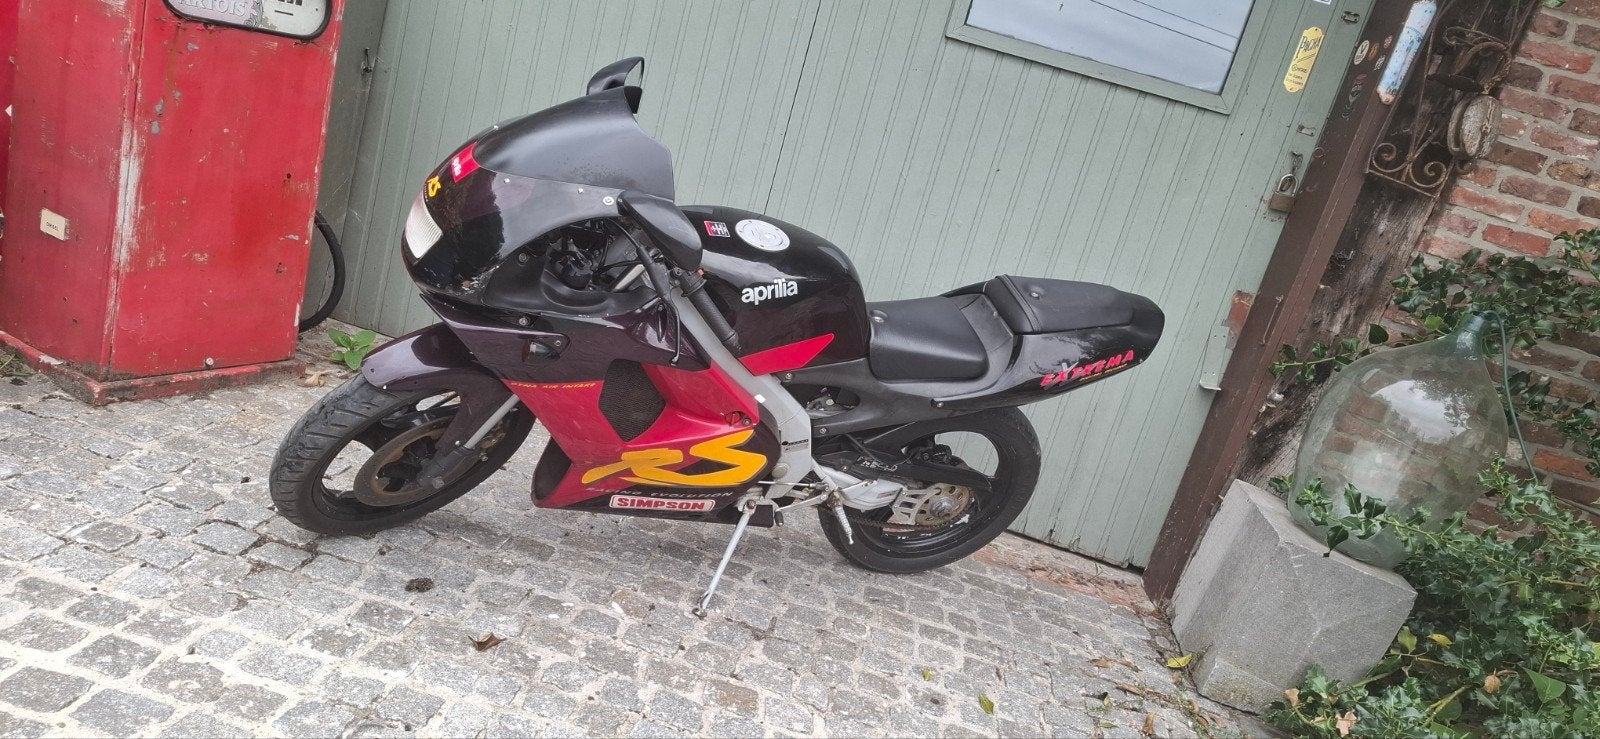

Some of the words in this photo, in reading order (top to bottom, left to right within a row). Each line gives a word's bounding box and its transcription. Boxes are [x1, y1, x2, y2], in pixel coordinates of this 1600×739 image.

[741, 278, 798, 305] aprilia
[1040, 349, 1134, 388] EXTREMA
[561, 382, 597, 390] INTAKE
[581, 428, 768, 488] RS
[585, 486, 643, 496] RACING
[650, 490, 734, 499] EVOLUTION
[616, 496, 706, 511] SIMPSON
